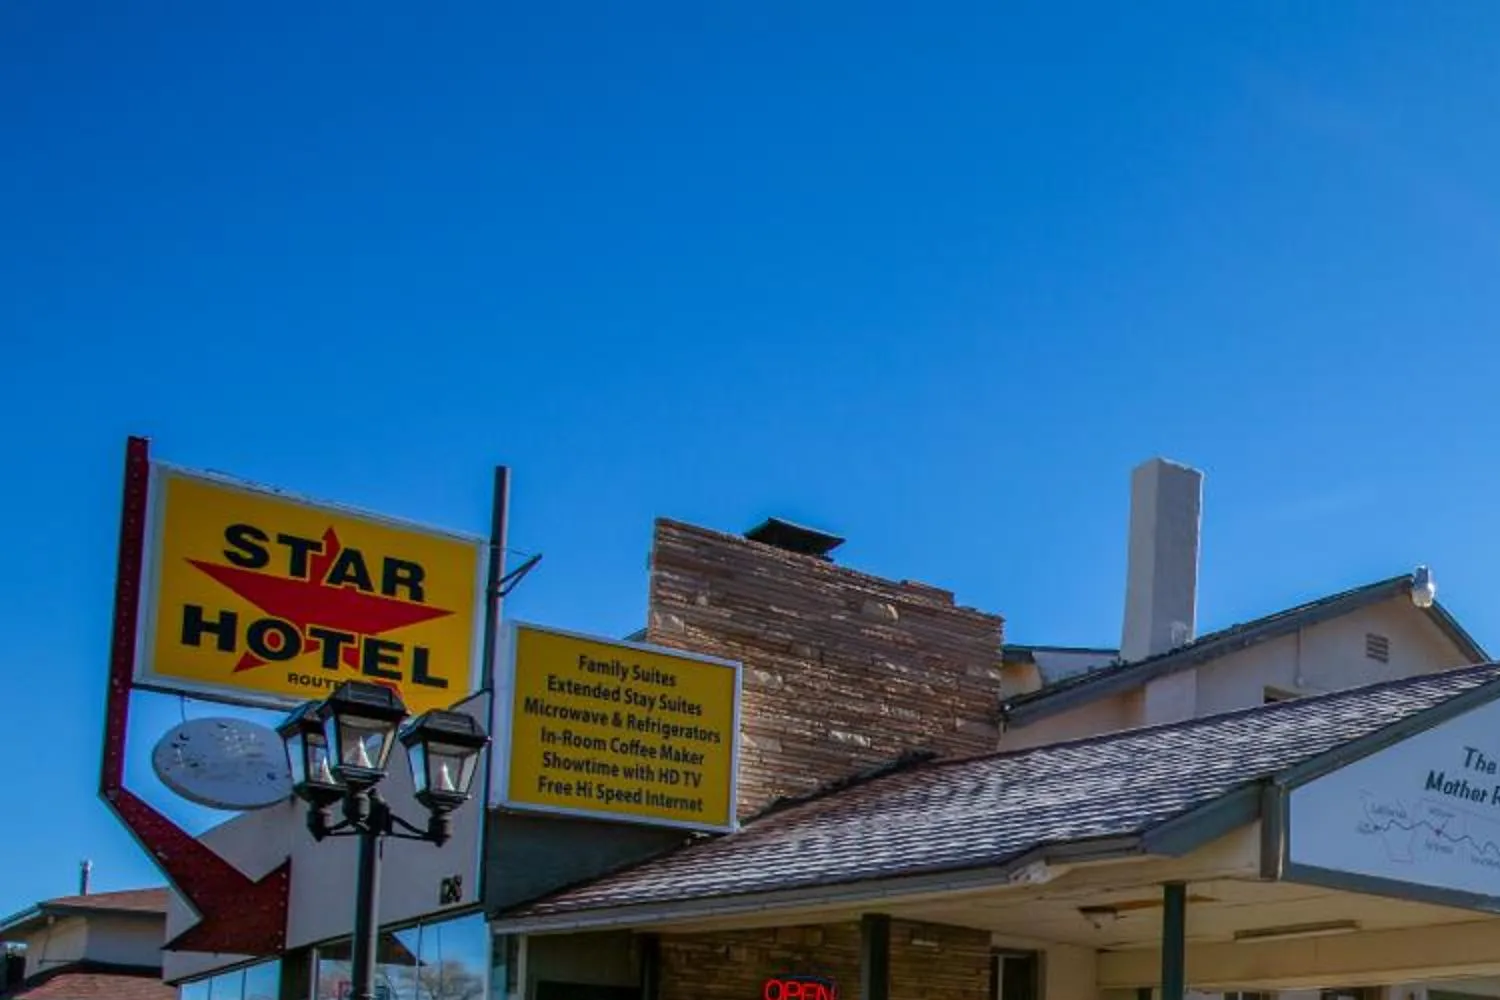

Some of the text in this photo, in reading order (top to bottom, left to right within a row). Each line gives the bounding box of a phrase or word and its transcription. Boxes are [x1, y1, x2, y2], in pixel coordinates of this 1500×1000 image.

[223, 523, 427, 603] STAR
[181, 604, 449, 689] HOTEL
[288, 673, 338, 690] ROUT
[578, 655, 677, 686] Family Suites
[547, 675, 703, 716] Extended Stay Suites
[524, 697, 721, 743] Microwave & Refrigerators
[541, 727, 705, 765] In-Room Coffee Maker
[1463, 745, 1497, 775] The
[543, 751, 703, 788] Showtime with HD TV
[1424, 769, 1489, 803] Mother
[538, 776, 704, 812] Free Hi Speed Internet
